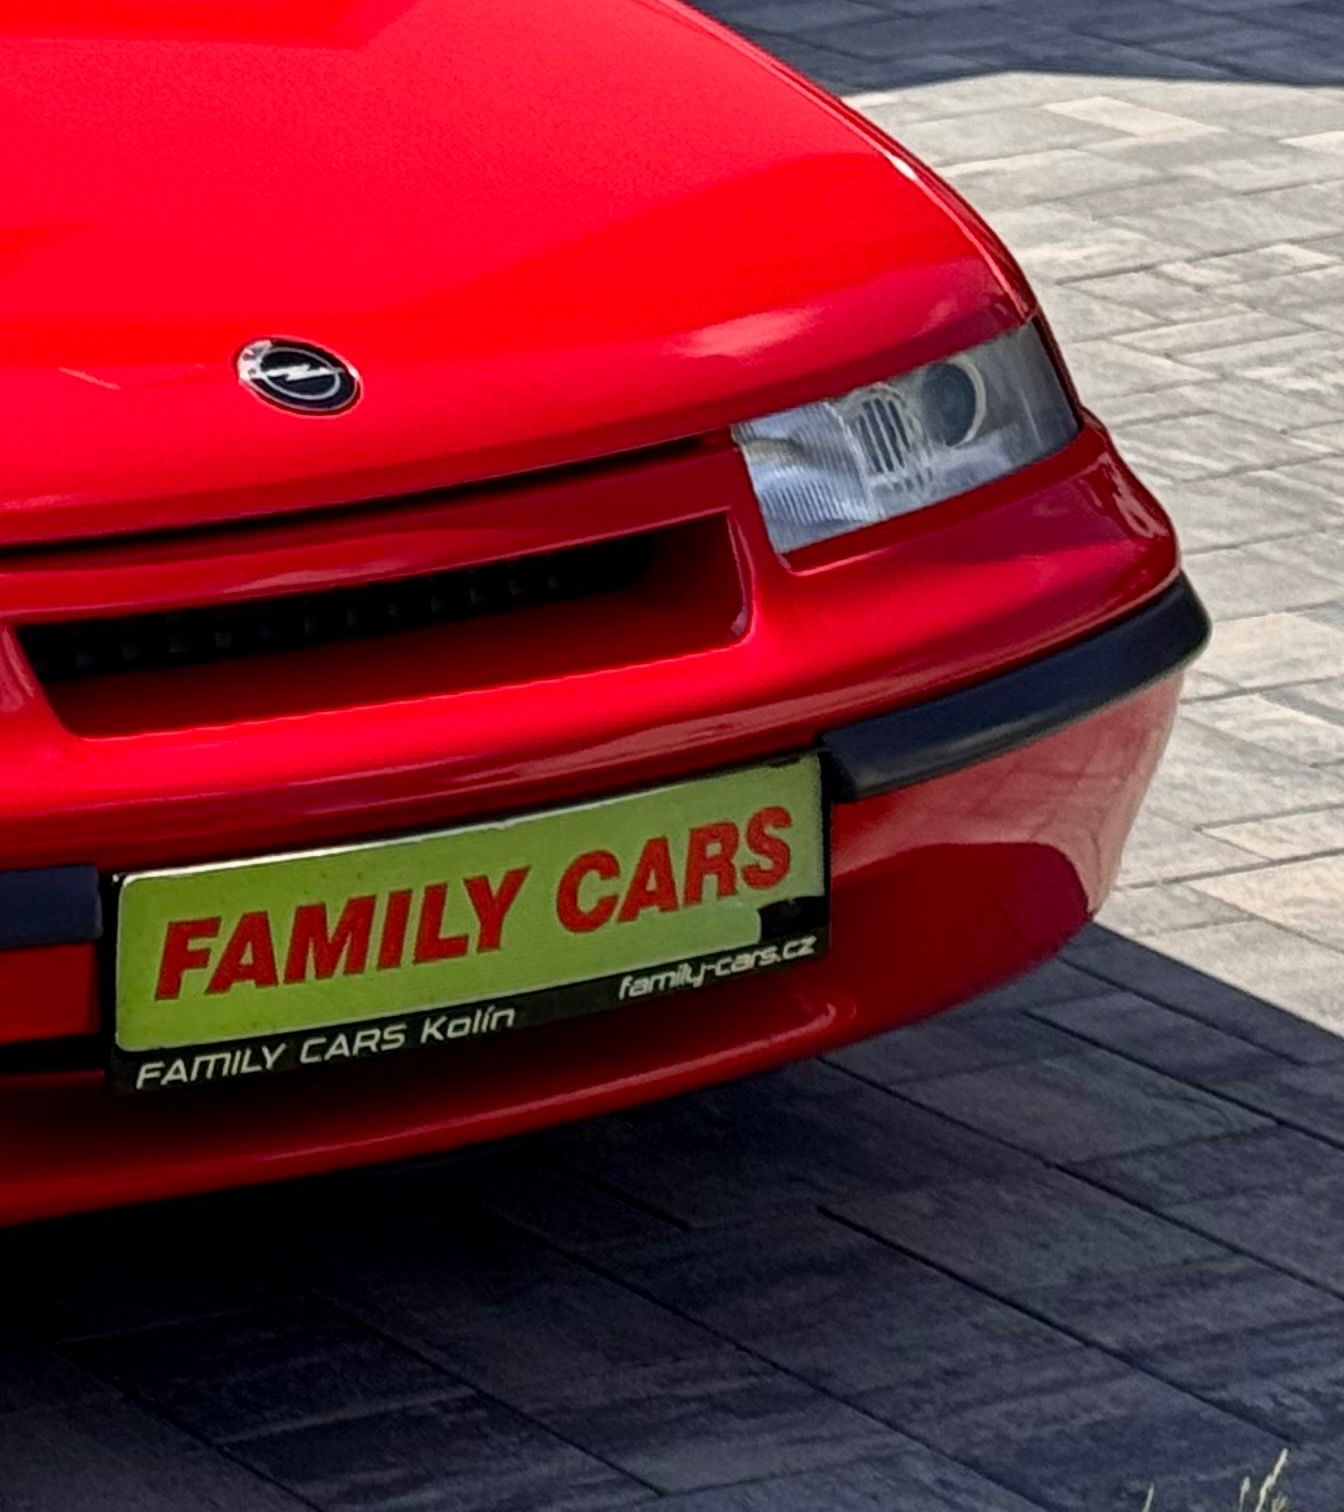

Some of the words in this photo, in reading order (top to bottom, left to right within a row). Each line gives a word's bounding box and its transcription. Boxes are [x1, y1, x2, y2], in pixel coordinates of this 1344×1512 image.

[154, 866, 531, 1001] FAMILY
[555, 805, 792, 934] CARS
[618, 936, 817, 1001] family-cars.cz
[135, 1042, 288, 1090] FAMILY
[299, 1023, 408, 1064] CARS
[419, 1004, 516, 1044] Kolín
